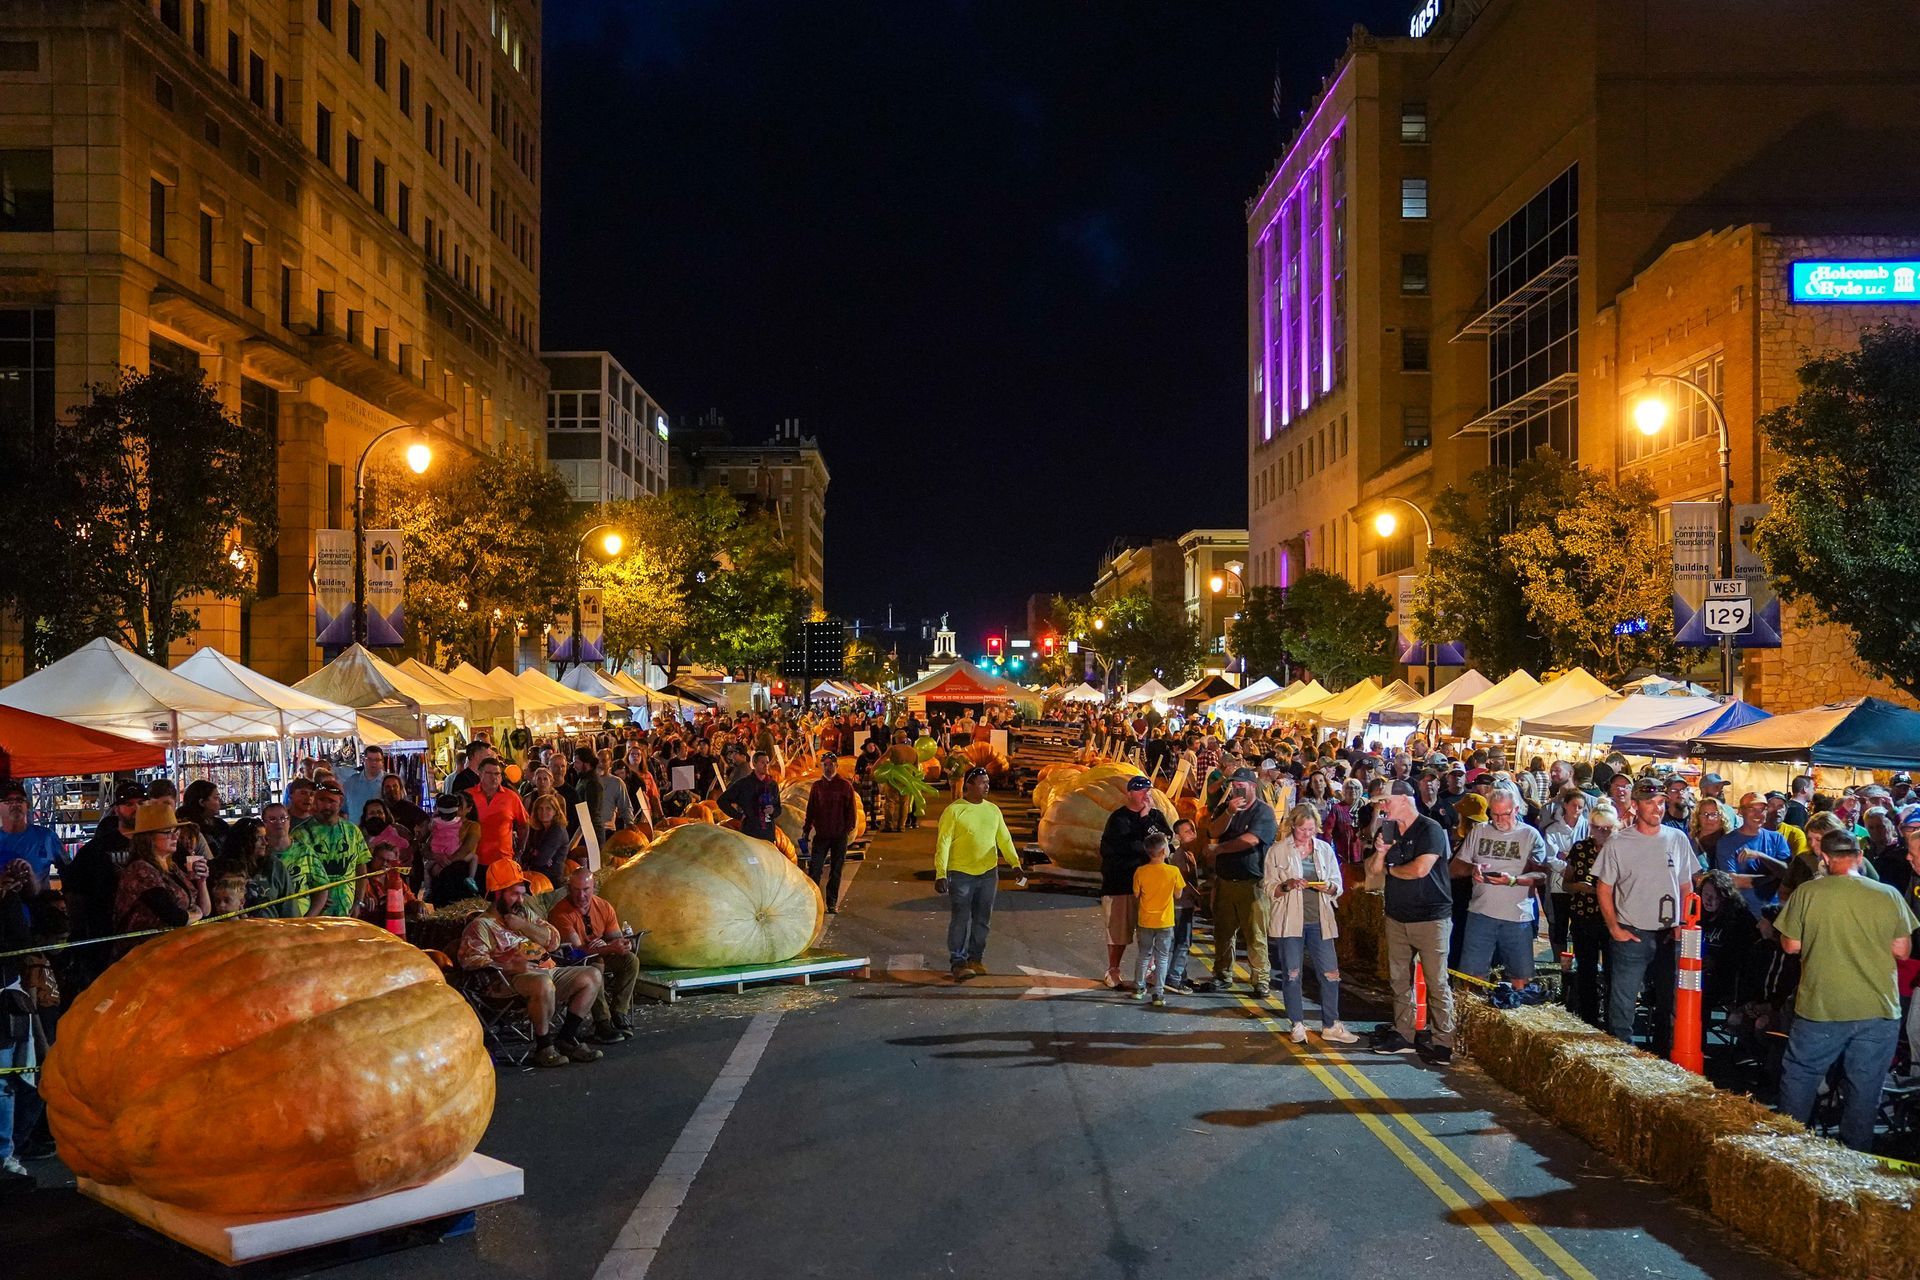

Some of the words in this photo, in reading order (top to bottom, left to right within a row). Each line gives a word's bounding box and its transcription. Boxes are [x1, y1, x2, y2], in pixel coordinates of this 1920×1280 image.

[1816, 266, 1889, 280] Holcomb
[1805, 271, 1821, 295] &
[1820, 281, 1863, 298] Hyde
[1865, 286, 1886, 295] LLC
[1674, 531, 1716, 540] Community
[1675, 539, 1715, 547] Foundation
[318, 552, 351, 560] Community
[1674, 563, 1709, 573] Building
[318, 579, 346, 587] Building
[368, 580, 393, 588] Growing
[368, 587, 402, 595] Philanthropy
[1714, 583, 1741, 593] WEST
[1710, 608, 1744, 624] 129
[1478, 837, 1521, 860] USA
